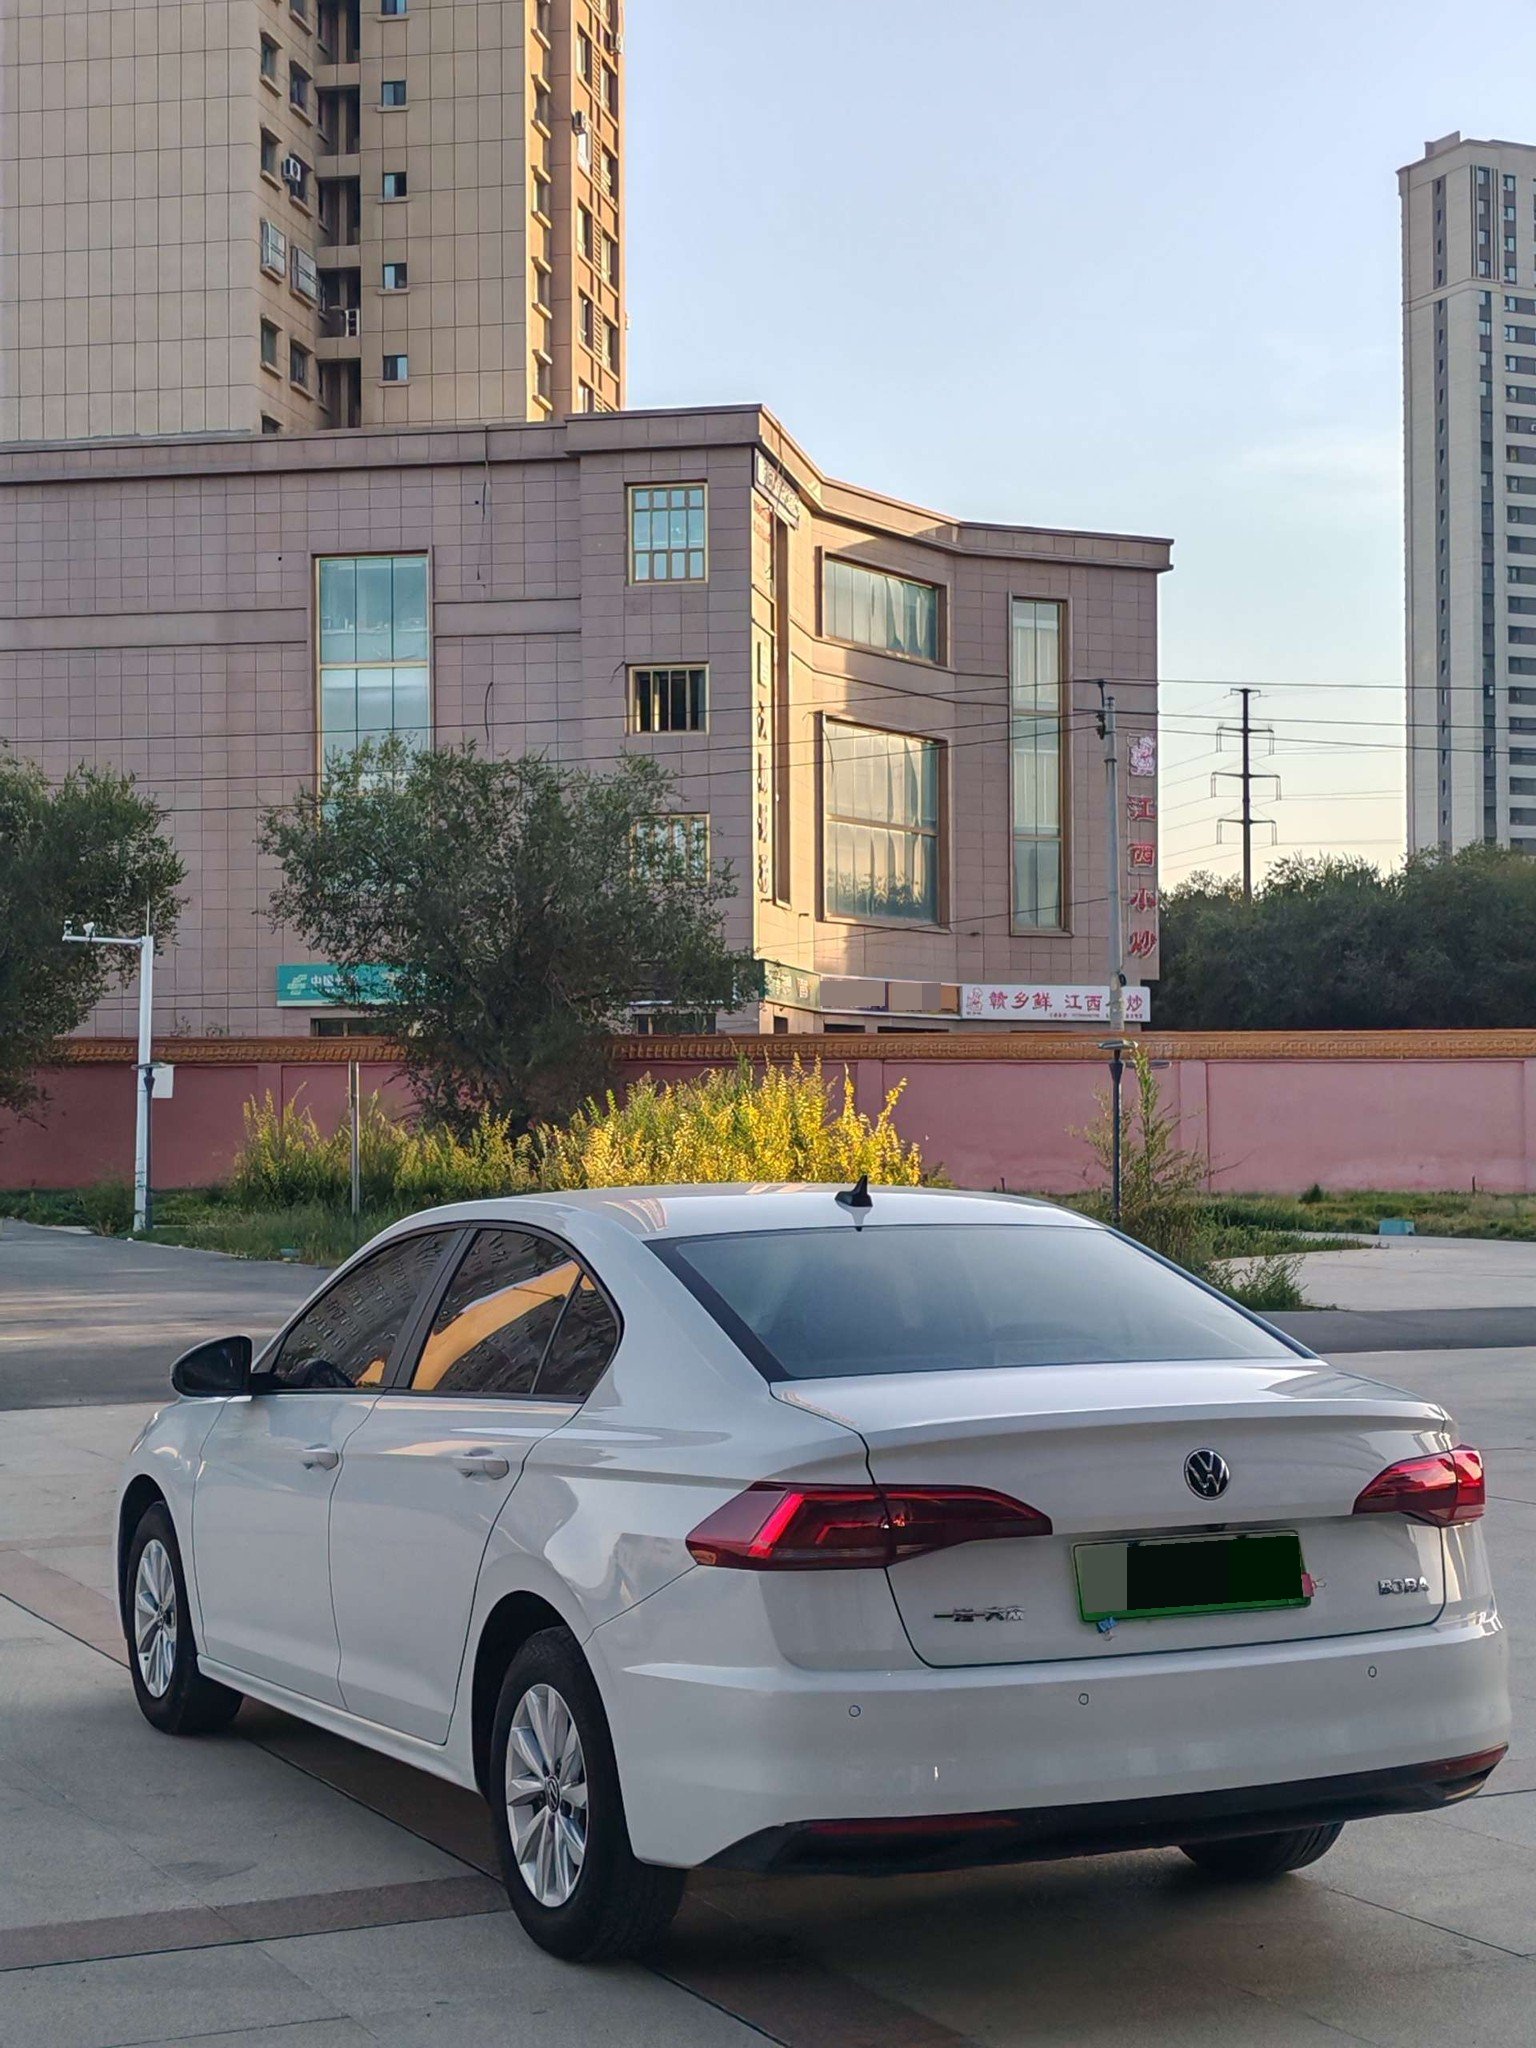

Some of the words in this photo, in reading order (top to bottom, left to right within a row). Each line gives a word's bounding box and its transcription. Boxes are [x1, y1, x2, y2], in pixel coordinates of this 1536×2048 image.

[1129, 797, 1157, 958] 江西小炒
[1064, 993, 1144, 1012] 江西炒
